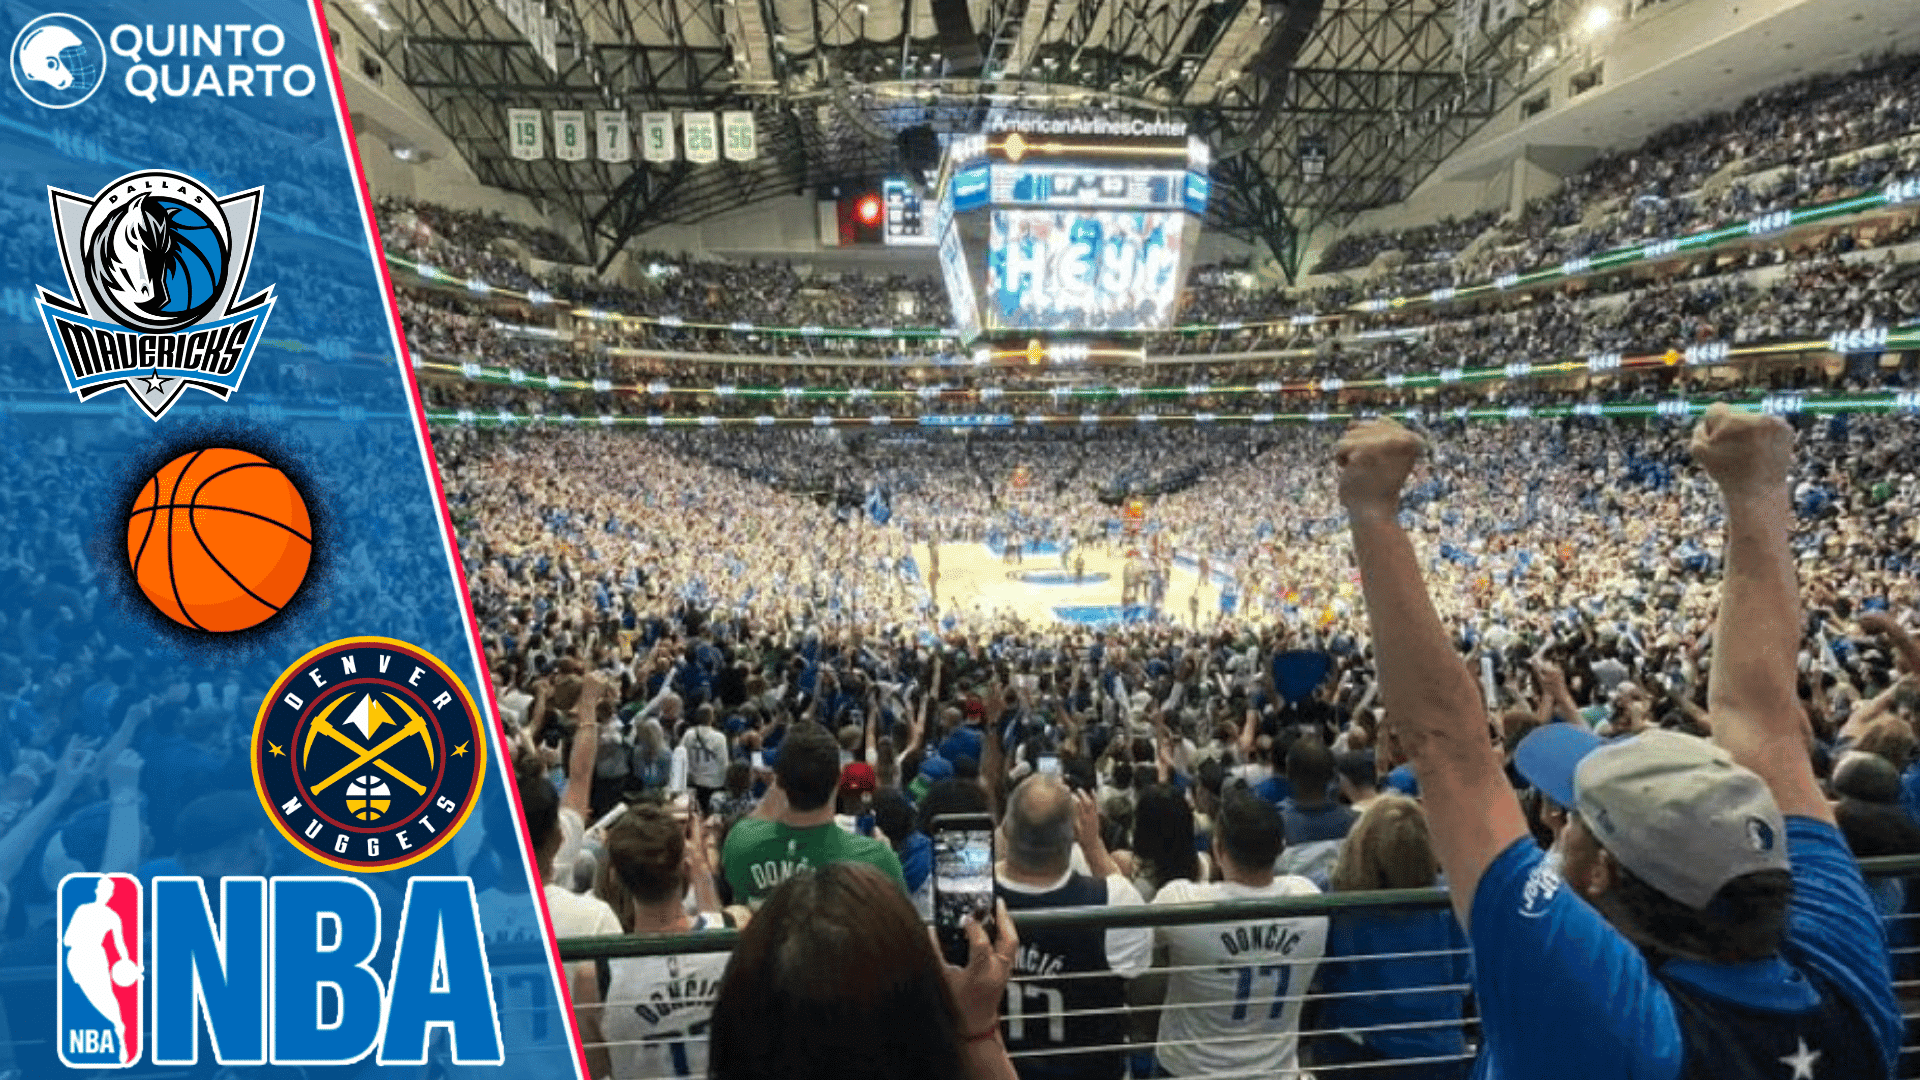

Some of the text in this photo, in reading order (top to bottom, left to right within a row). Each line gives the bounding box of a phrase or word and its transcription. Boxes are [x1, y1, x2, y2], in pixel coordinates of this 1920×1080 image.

[517, 122, 536, 147] 19
[564, 123, 577, 147] 8
[606, 125, 619, 149] 7
[1217, 963, 1291, 1020] 77
